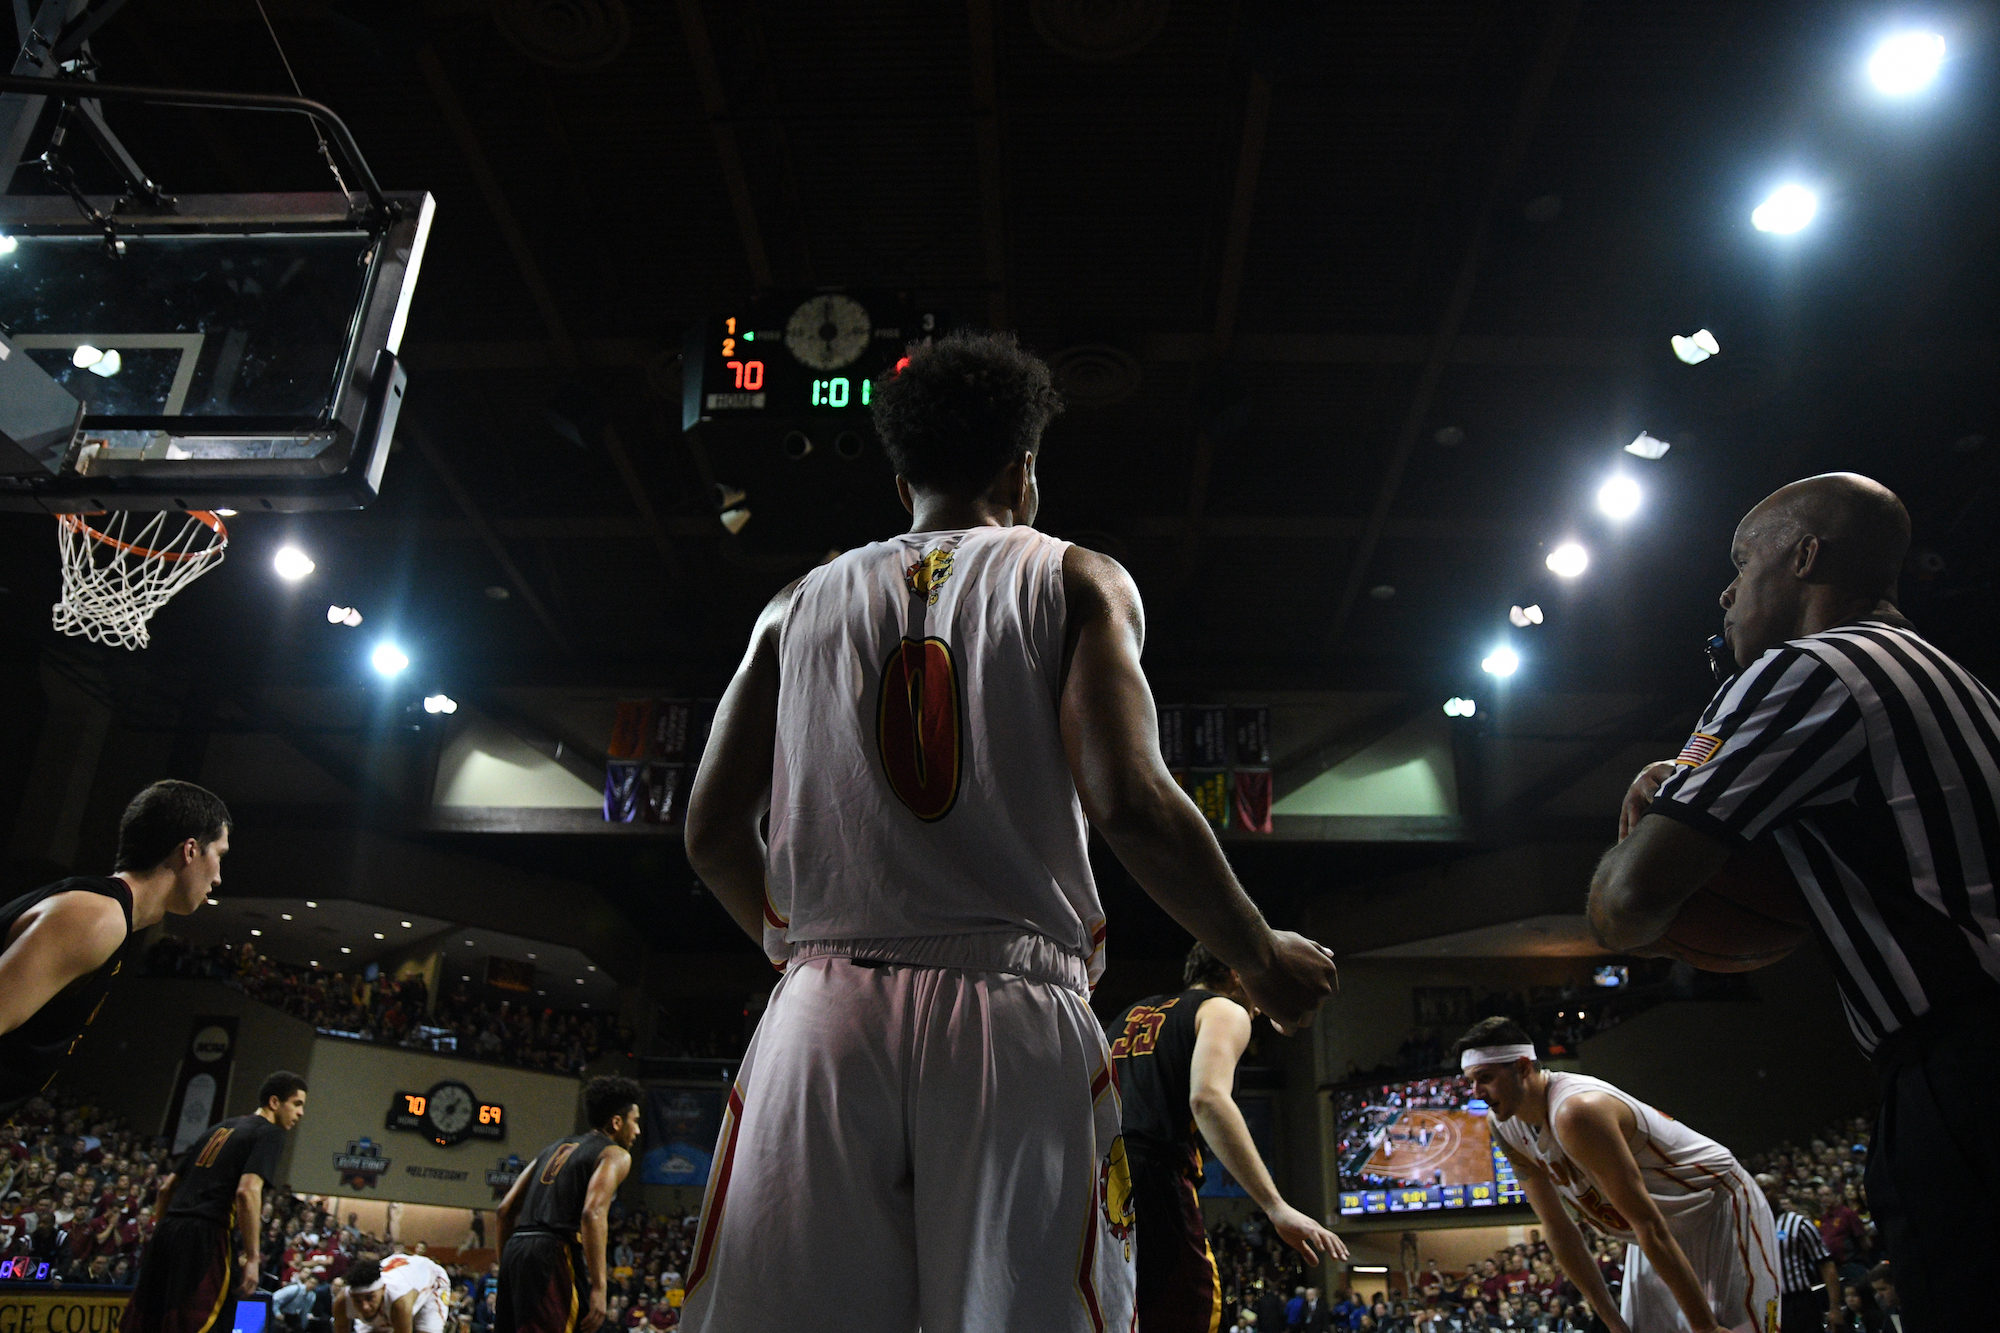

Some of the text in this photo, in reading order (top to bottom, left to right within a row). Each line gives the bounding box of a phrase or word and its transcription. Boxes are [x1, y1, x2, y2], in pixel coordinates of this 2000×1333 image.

[725, 316, 737, 335] 1
[922, 313, 935, 332] 3
[721, 337, 736, 357] 2
[726, 360, 764, 390] 70
[875, 636, 962, 823] 0
[404, 1094, 427, 1117] 70
[478, 1104, 502, 1125] 69
[1401, 1191, 1428, 1203] 1:01
